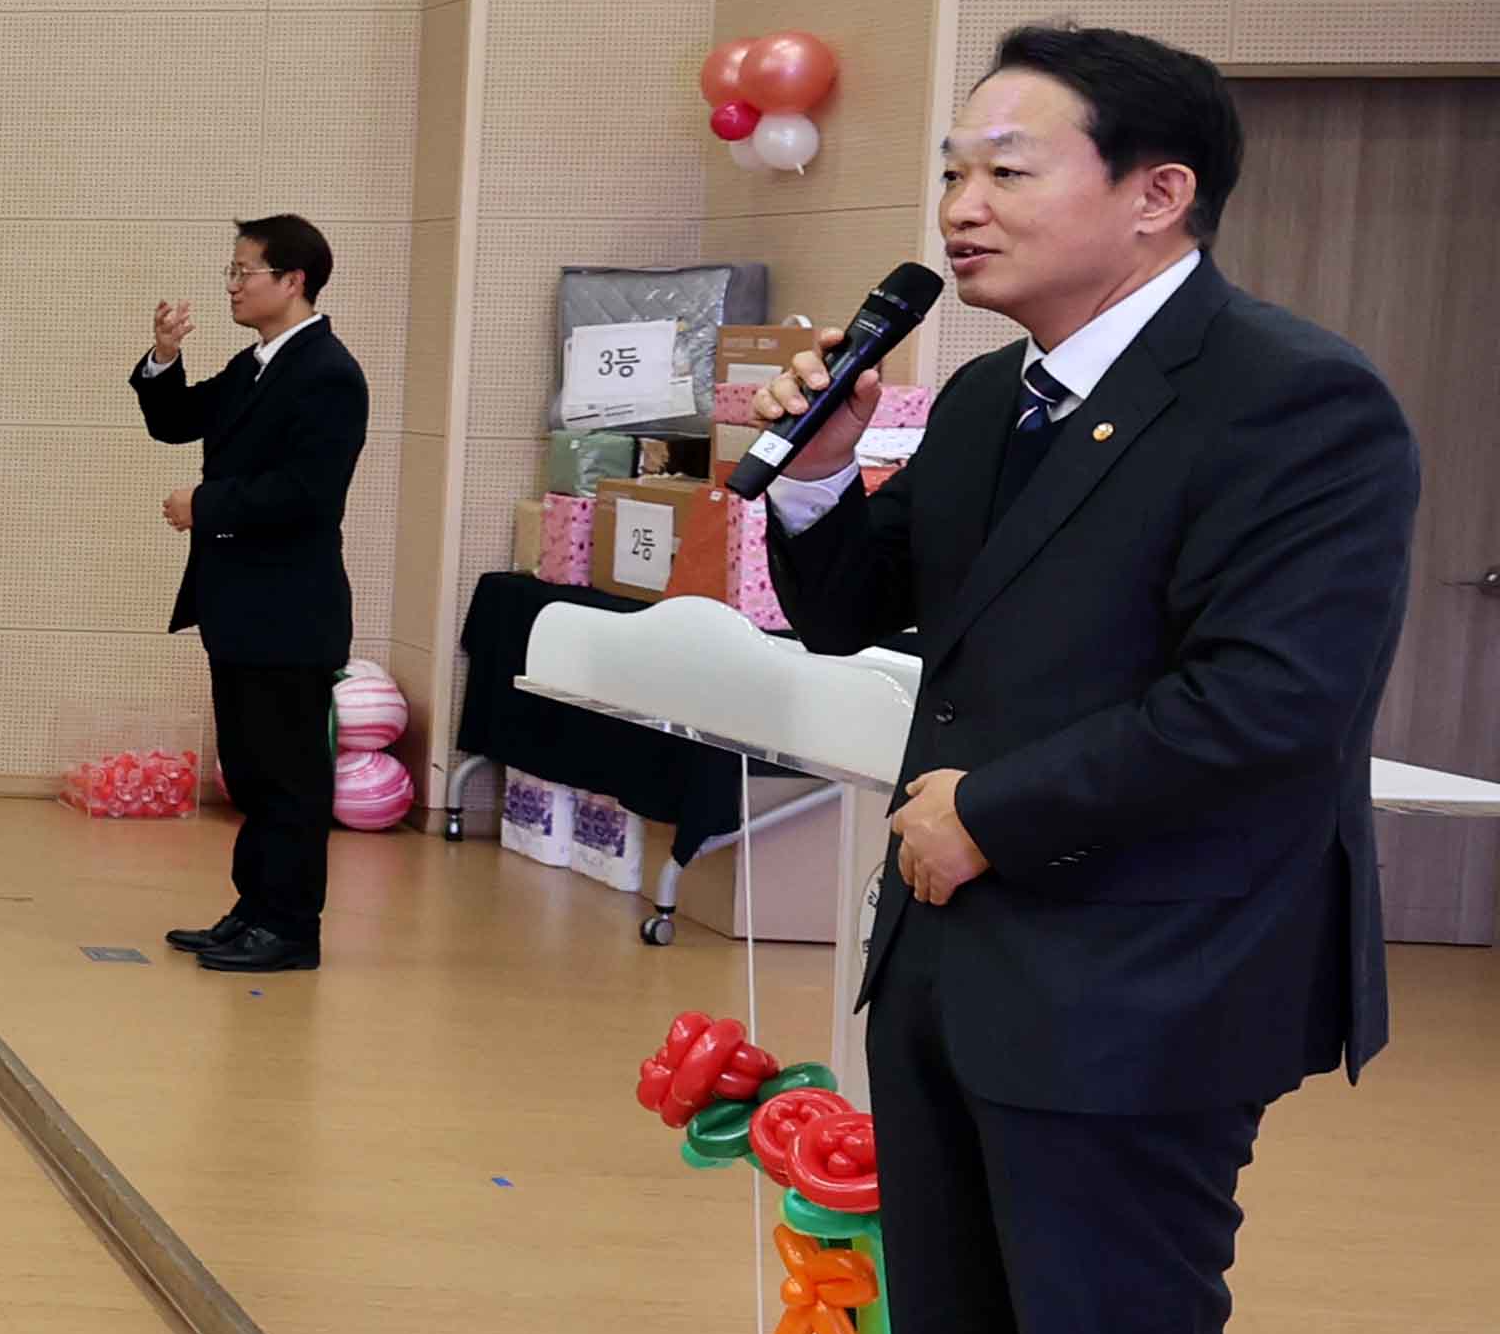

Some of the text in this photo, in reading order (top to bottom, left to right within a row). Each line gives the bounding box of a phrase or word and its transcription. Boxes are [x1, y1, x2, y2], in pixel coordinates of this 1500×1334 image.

[598, 347, 641, 378] 3등
[763, 442, 777, 454] 2
[631, 528, 656, 561] 2등
